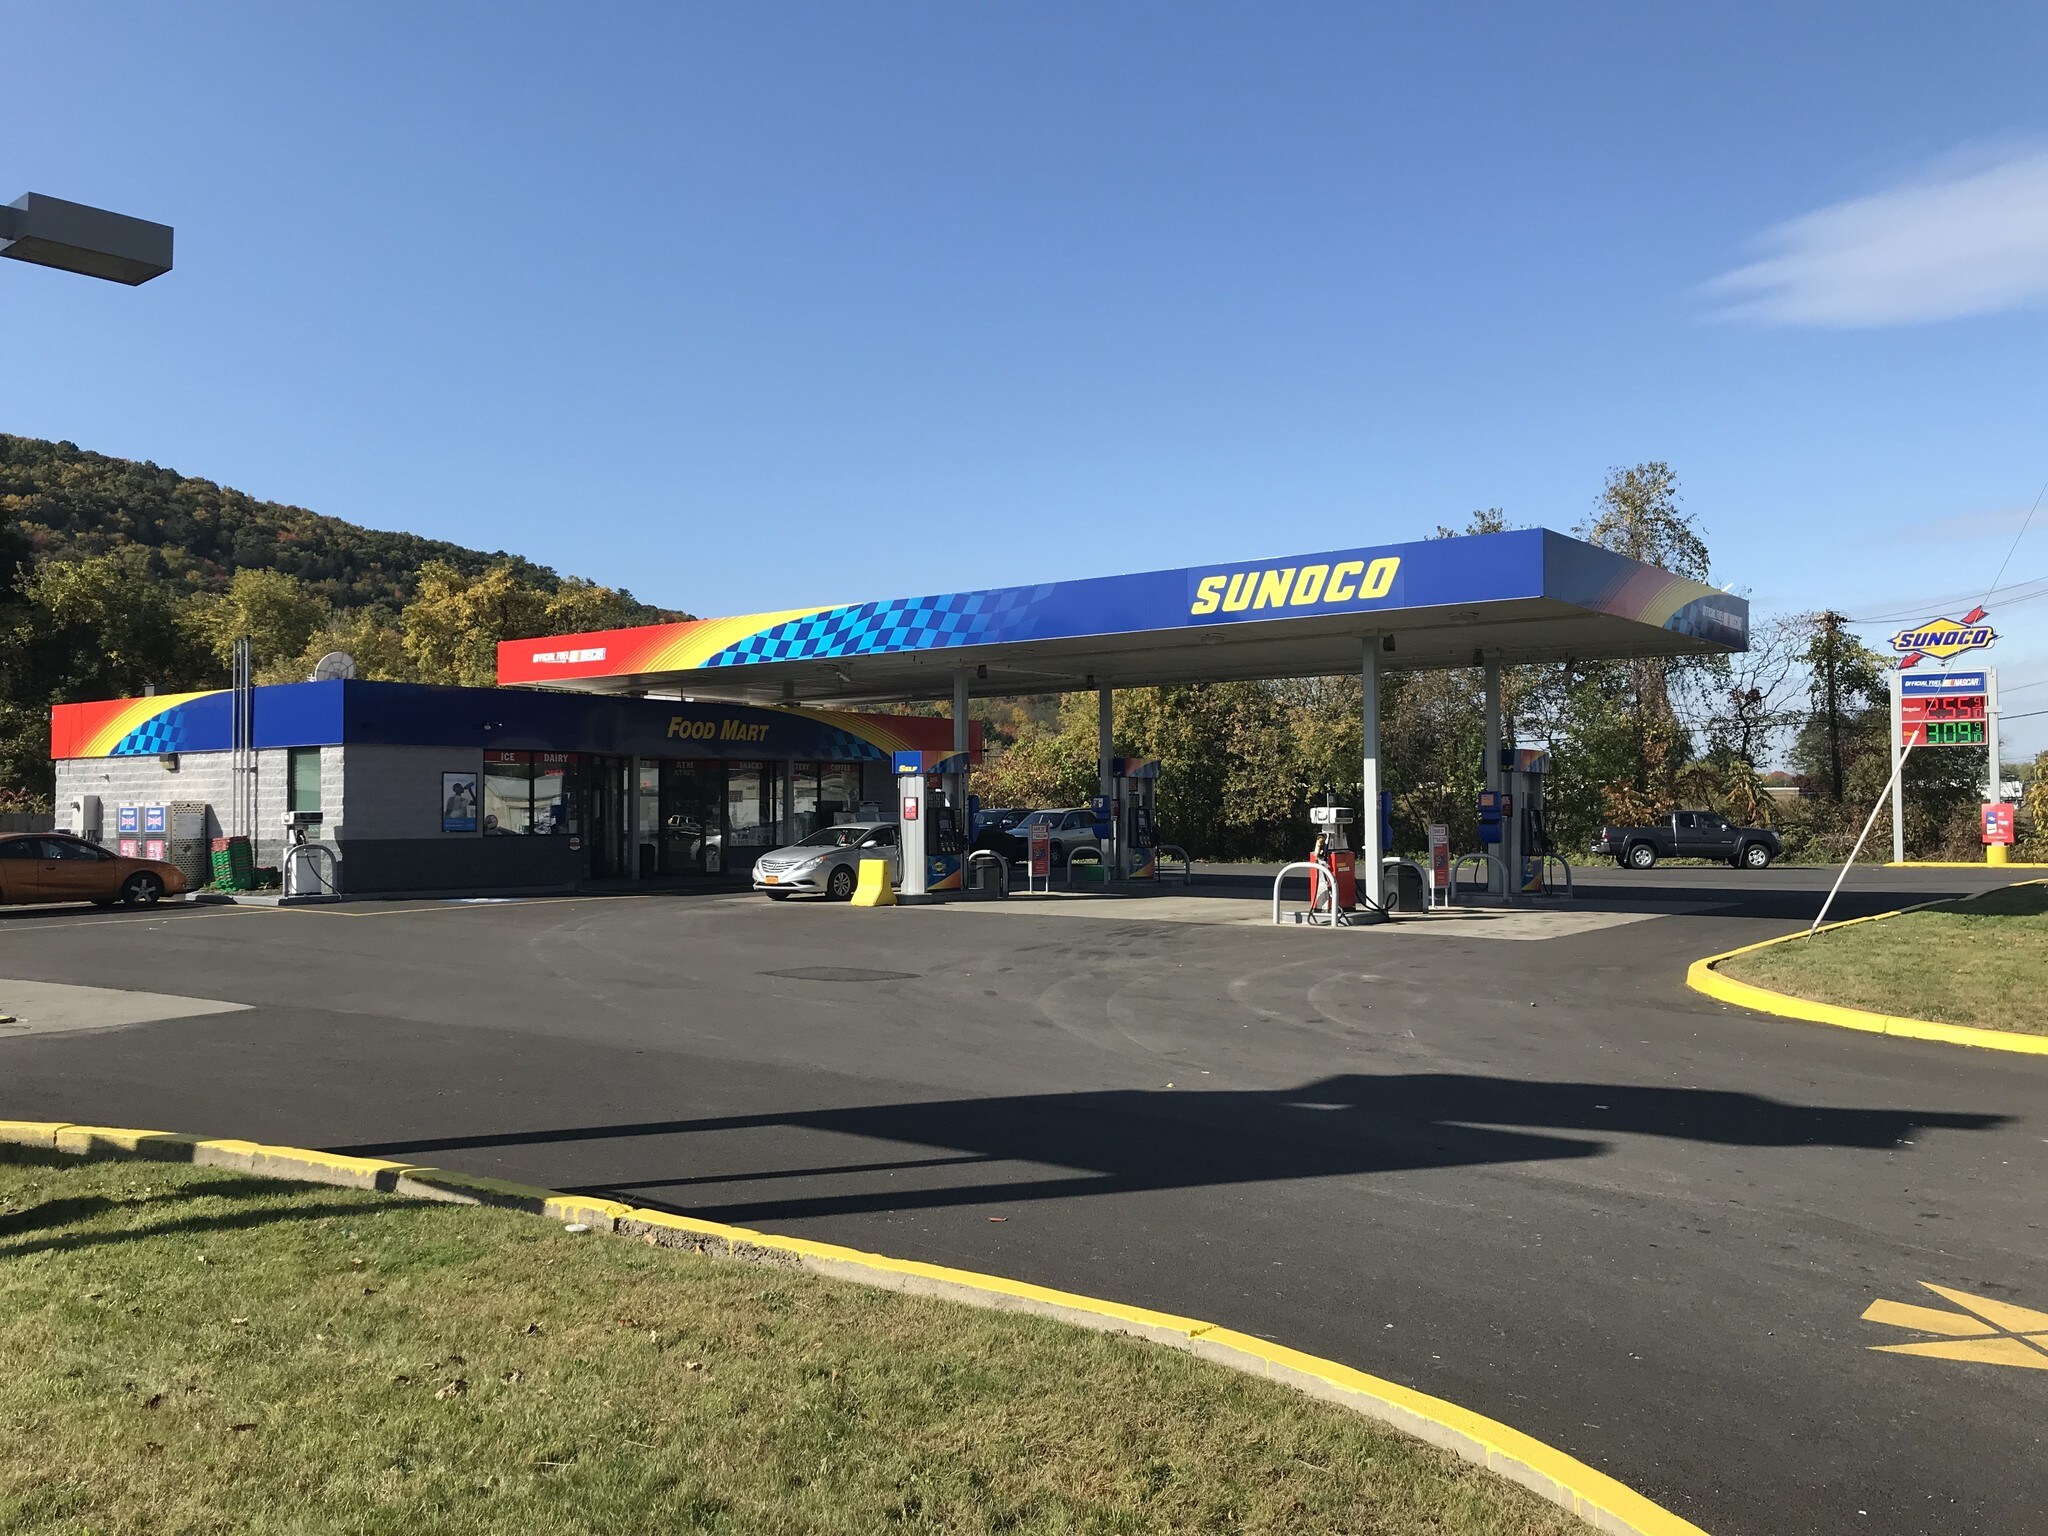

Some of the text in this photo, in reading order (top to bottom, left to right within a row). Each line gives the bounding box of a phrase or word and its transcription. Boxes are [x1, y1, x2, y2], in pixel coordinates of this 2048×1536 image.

[1191, 557, 1401, 615] SUNOCO
[1898, 630, 1989, 648] SUNOCO
[1928, 722, 1971, 744] 3.09
[501, 753, 515, 761] ICE
[544, 754, 568, 763] DAIRY
[676, 761, 694, 769] ATM
[739, 761, 763, 770] SNACKS
